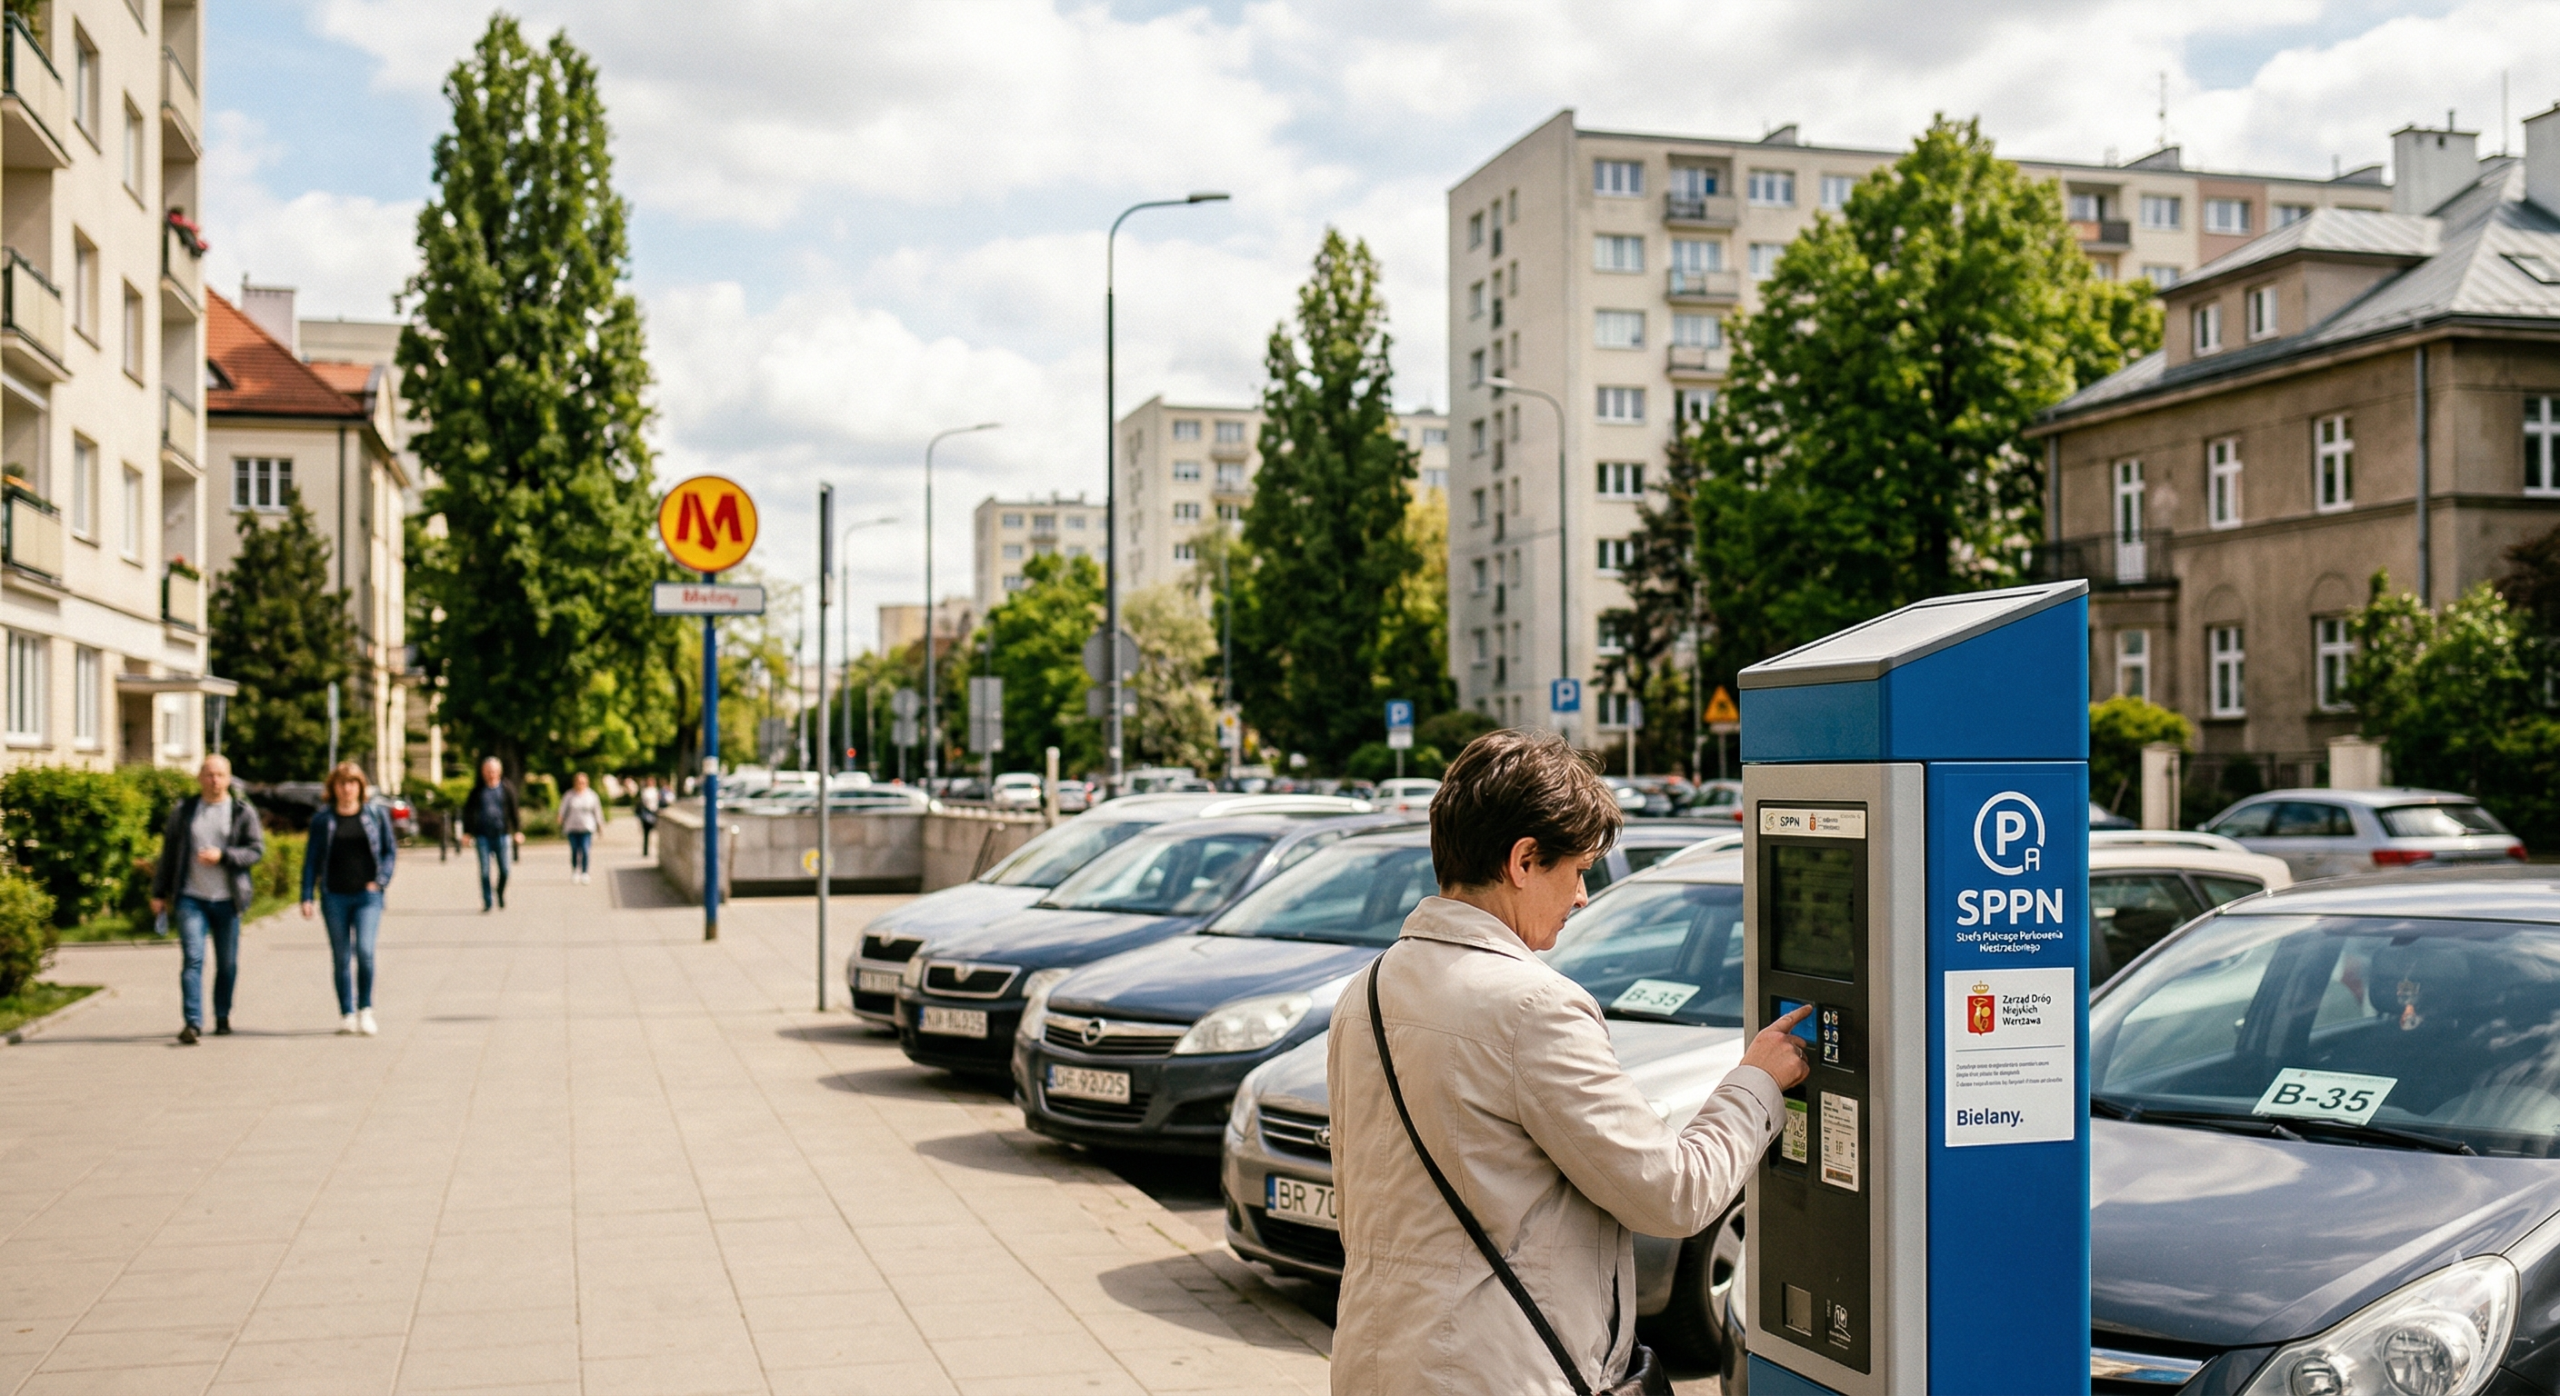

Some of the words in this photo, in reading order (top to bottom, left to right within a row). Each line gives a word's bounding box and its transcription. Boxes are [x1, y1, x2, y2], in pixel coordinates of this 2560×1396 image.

[676, 492, 743, 552] M
[1557, 682, 1576, 708] P
[1391, 702, 1409, 725] P
[1780, 816, 1800, 827] SPPN
[1996, 810, 2026, 856] P
[1956, 888, 2063, 926] SPPN
[1624, 988, 1684, 1007] B-35
[2031, 993, 2052, 1005] Dróg
[2271, 1083, 2375, 1112] B-35
[1957, 1108, 2024, 1127] Bielany.
[1279, 1181, 1307, 1213] BR
